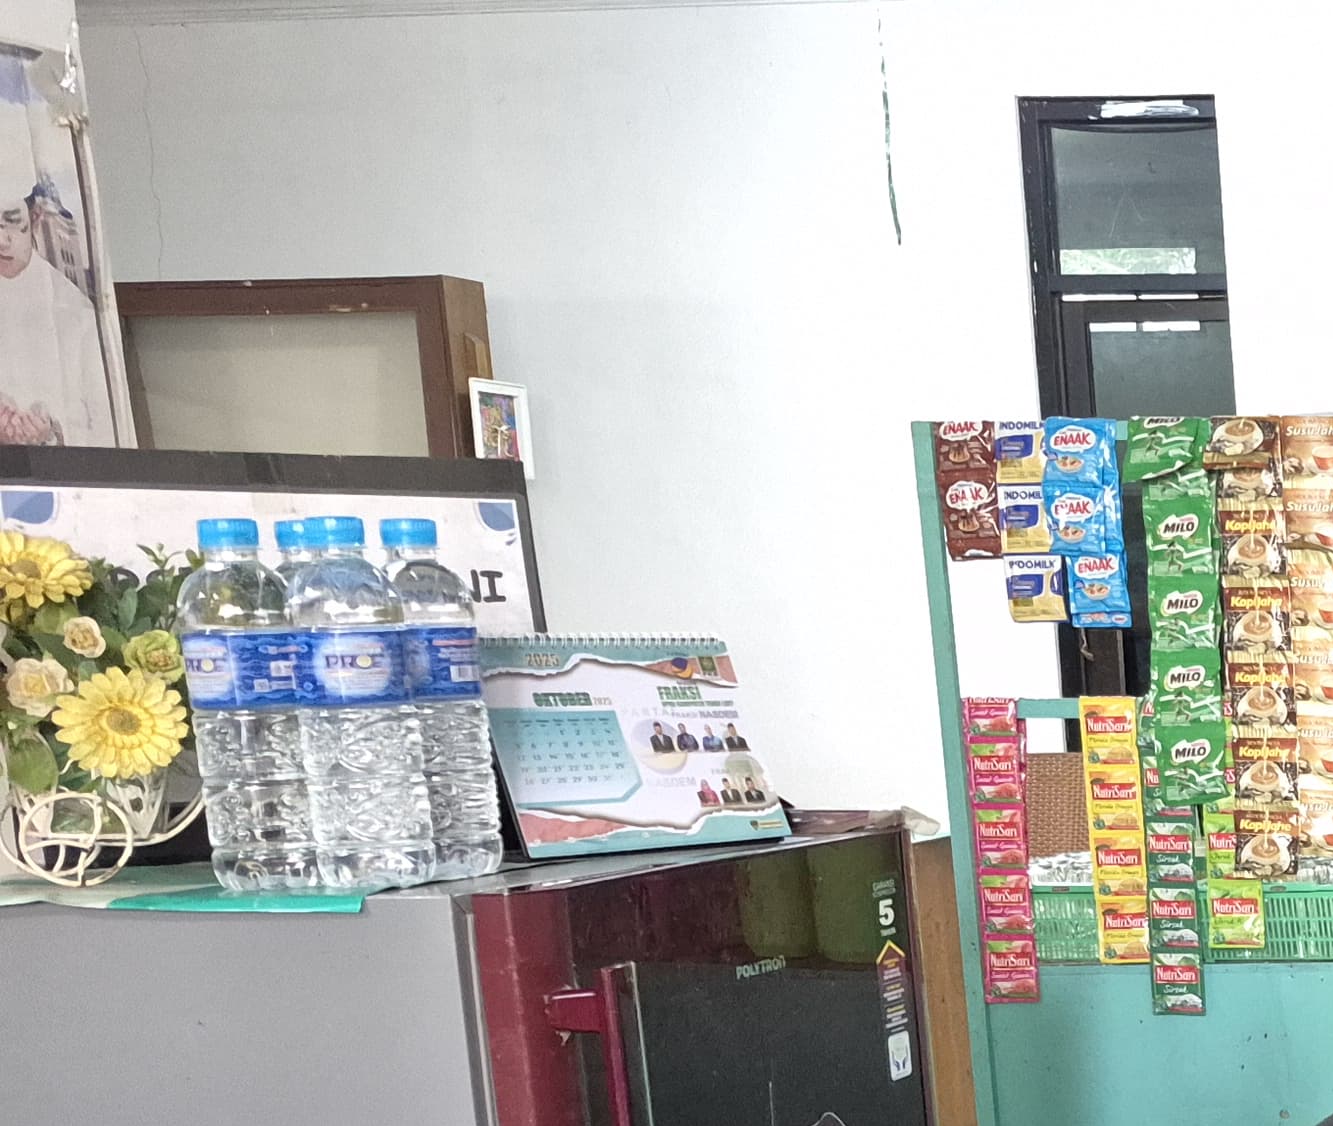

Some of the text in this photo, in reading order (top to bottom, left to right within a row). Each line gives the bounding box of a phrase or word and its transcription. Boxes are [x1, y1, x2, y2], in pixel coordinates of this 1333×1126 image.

[1163, 521, 1195, 534] MILO
[1166, 598, 1199, 610] MILO
[1169, 671, 1202, 686] MILO
[1174, 745, 1207, 760] MILO
[1097, 850, 1138, 866] NutriSari
[879, 899, 895, 926] 5
[1153, 902, 1192, 916] NutriSari
[1213, 900, 1255, 914] NutriSari
[736, 955, 786, 980] POLYTRON
[1156, 967, 1196, 981] NutriSari
